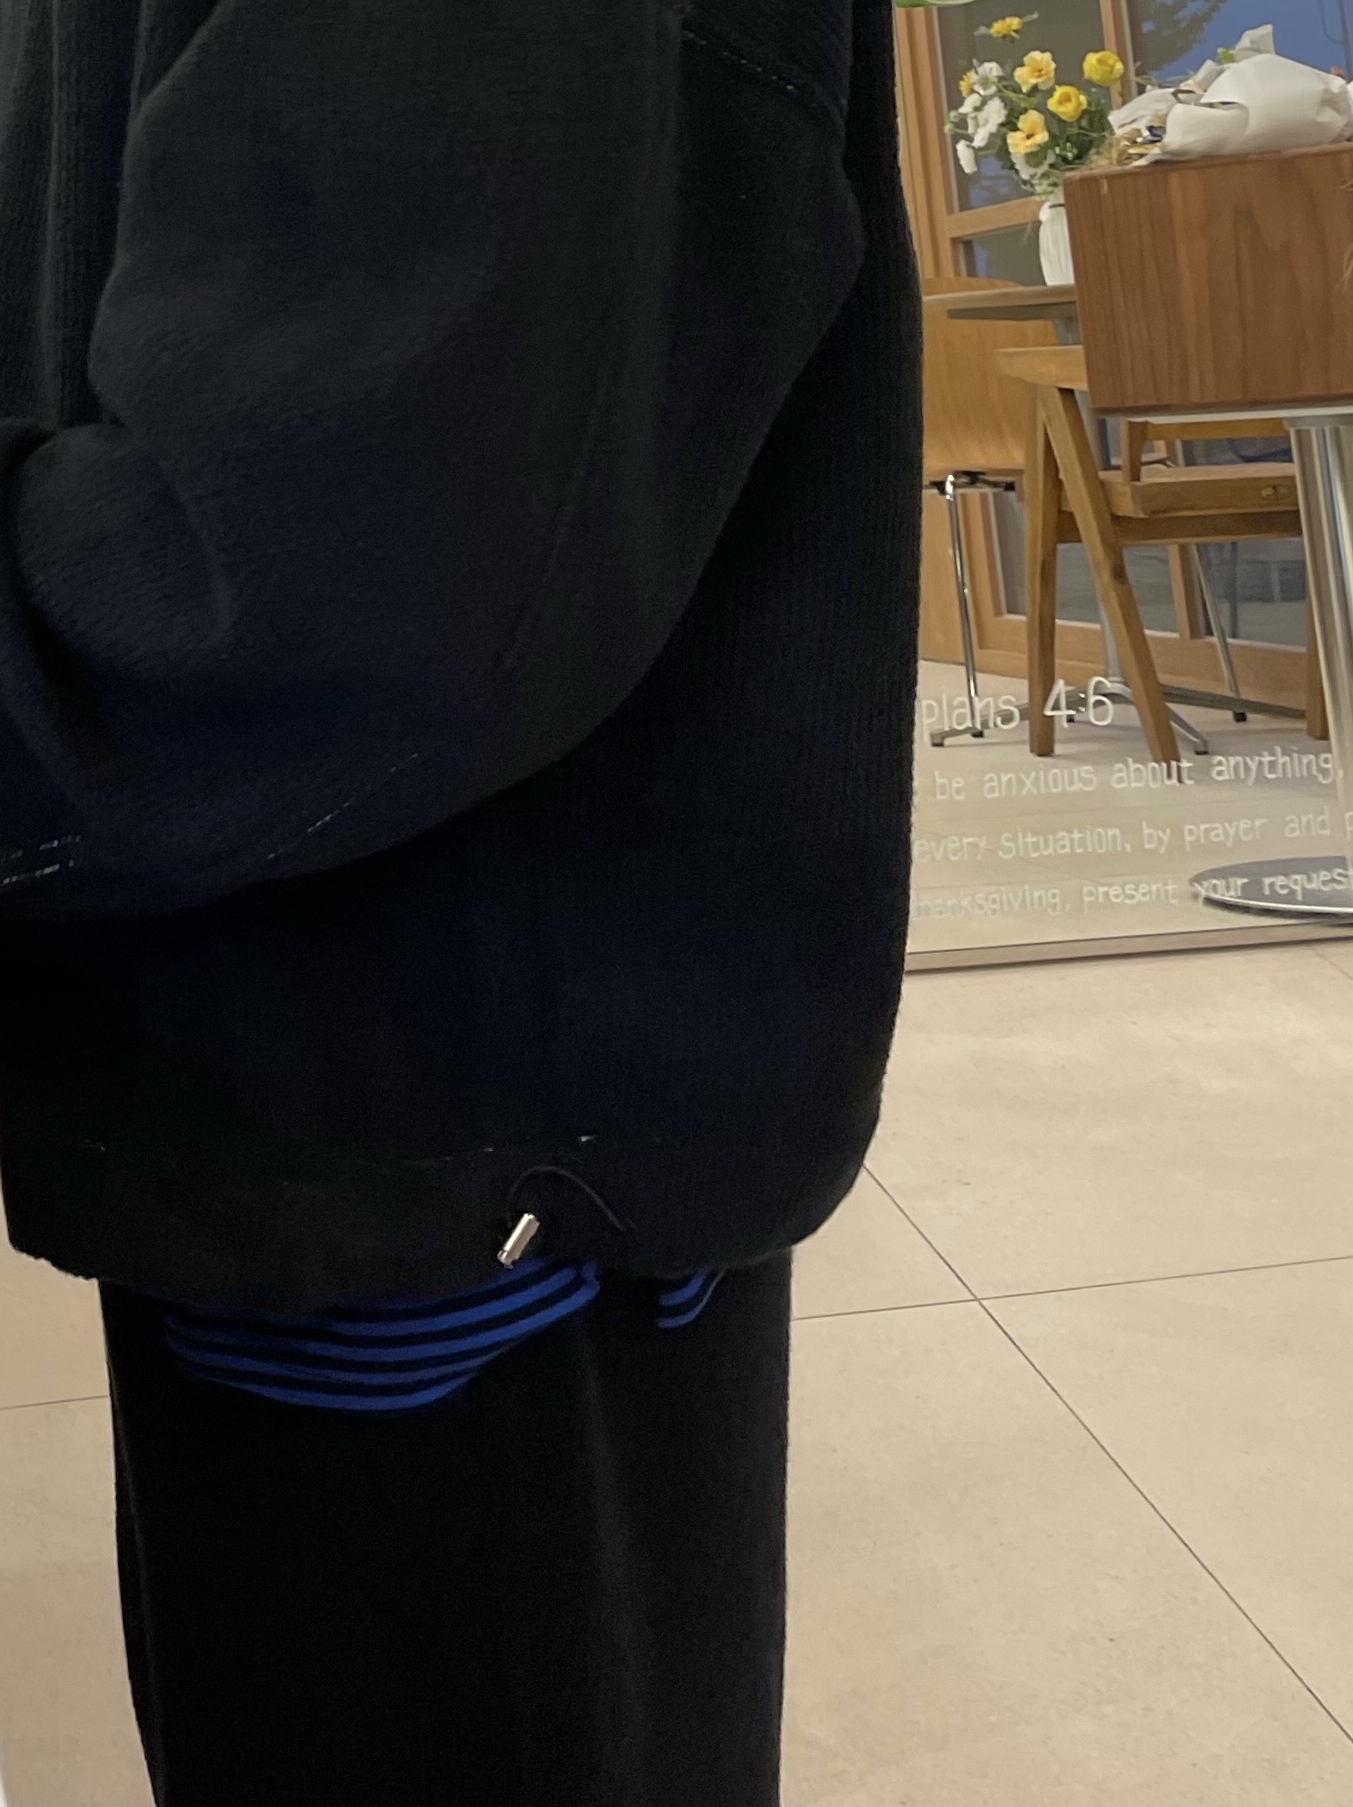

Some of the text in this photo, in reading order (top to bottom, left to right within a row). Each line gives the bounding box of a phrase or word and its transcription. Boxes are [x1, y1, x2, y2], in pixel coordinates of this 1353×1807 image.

[1043, 676, 1114, 728] 4:6
[934, 770, 966, 800] be
[983, 763, 1097, 798] anxious
[1111, 757, 1195, 789] about
[1142, 821, 1171, 854] by
[1184, 818, 1269, 851] prayer
[1284, 806, 1331, 838] and
[1082, 879, 1178, 914] present
[1191, 876, 1250, 905] your
